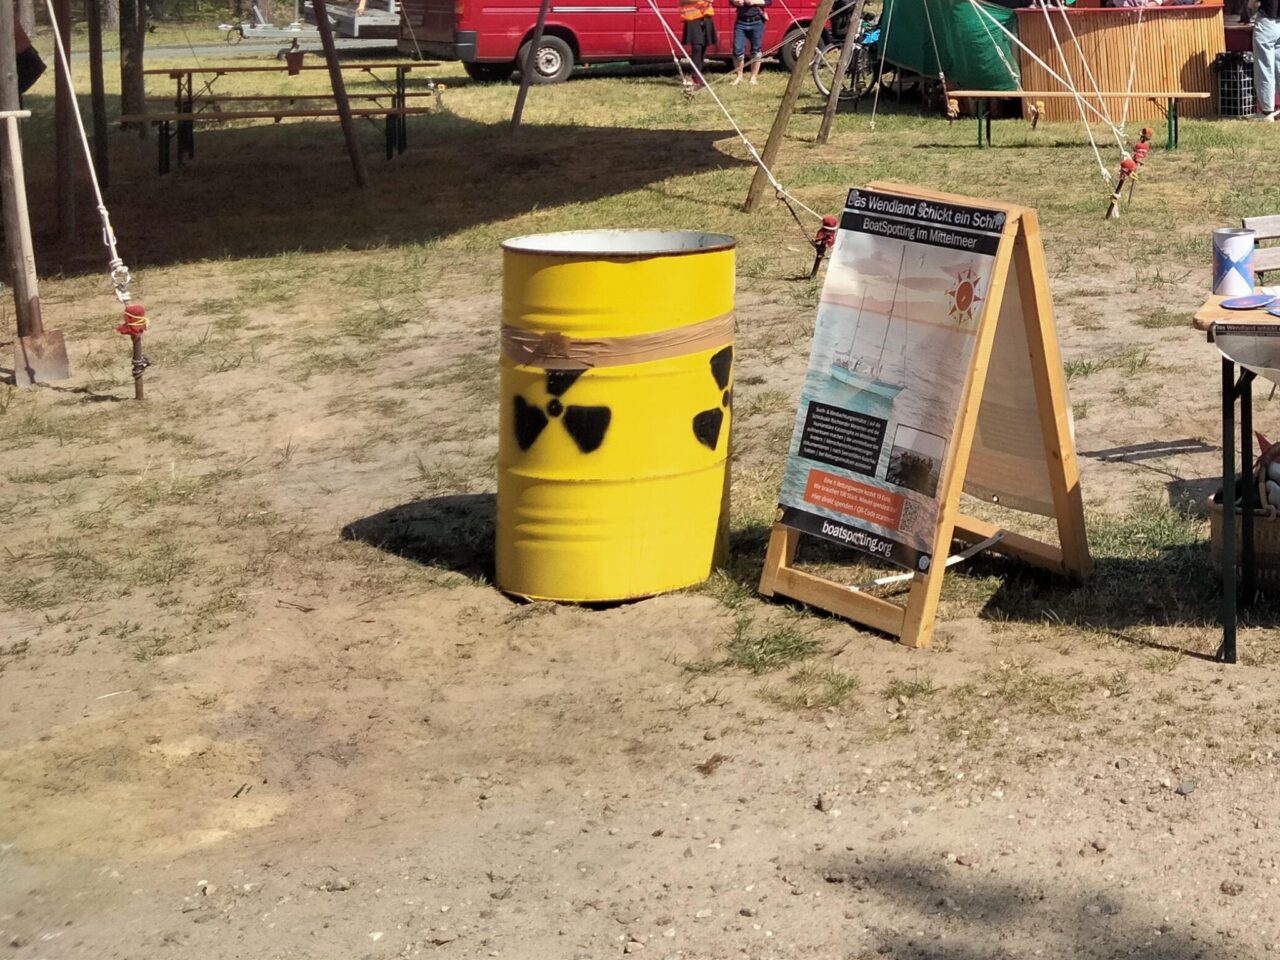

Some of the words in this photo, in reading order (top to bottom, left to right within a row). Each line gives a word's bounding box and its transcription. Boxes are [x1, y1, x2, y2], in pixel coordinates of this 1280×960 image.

[868, 196, 917, 216] Wendland
[954, 211, 970, 225] ein
[863, 218, 915, 240] BoatSpotting
[916, 226, 928, 240] im
[929, 228, 978, 248] Mittelmeer
[822, 520, 893, 558] boatspotting.org
